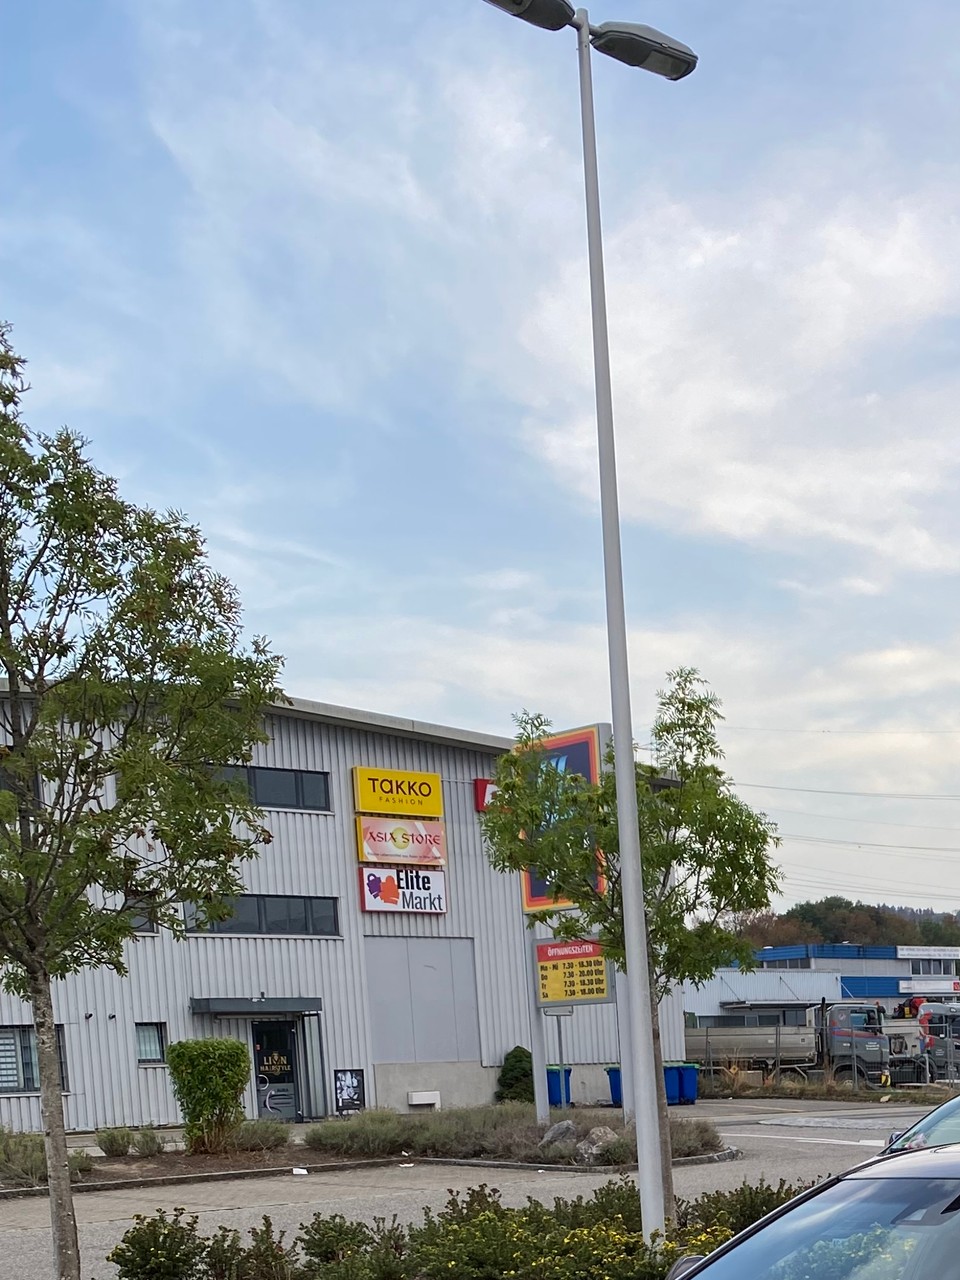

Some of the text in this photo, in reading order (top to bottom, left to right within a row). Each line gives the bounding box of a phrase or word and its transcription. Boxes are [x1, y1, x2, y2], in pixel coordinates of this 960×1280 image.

[379, 797, 423, 806] FASHION
[367, 831, 441, 846] ASIA STORE
[396, 869, 431, 891] Elite
[402, 891, 443, 911] Markt
